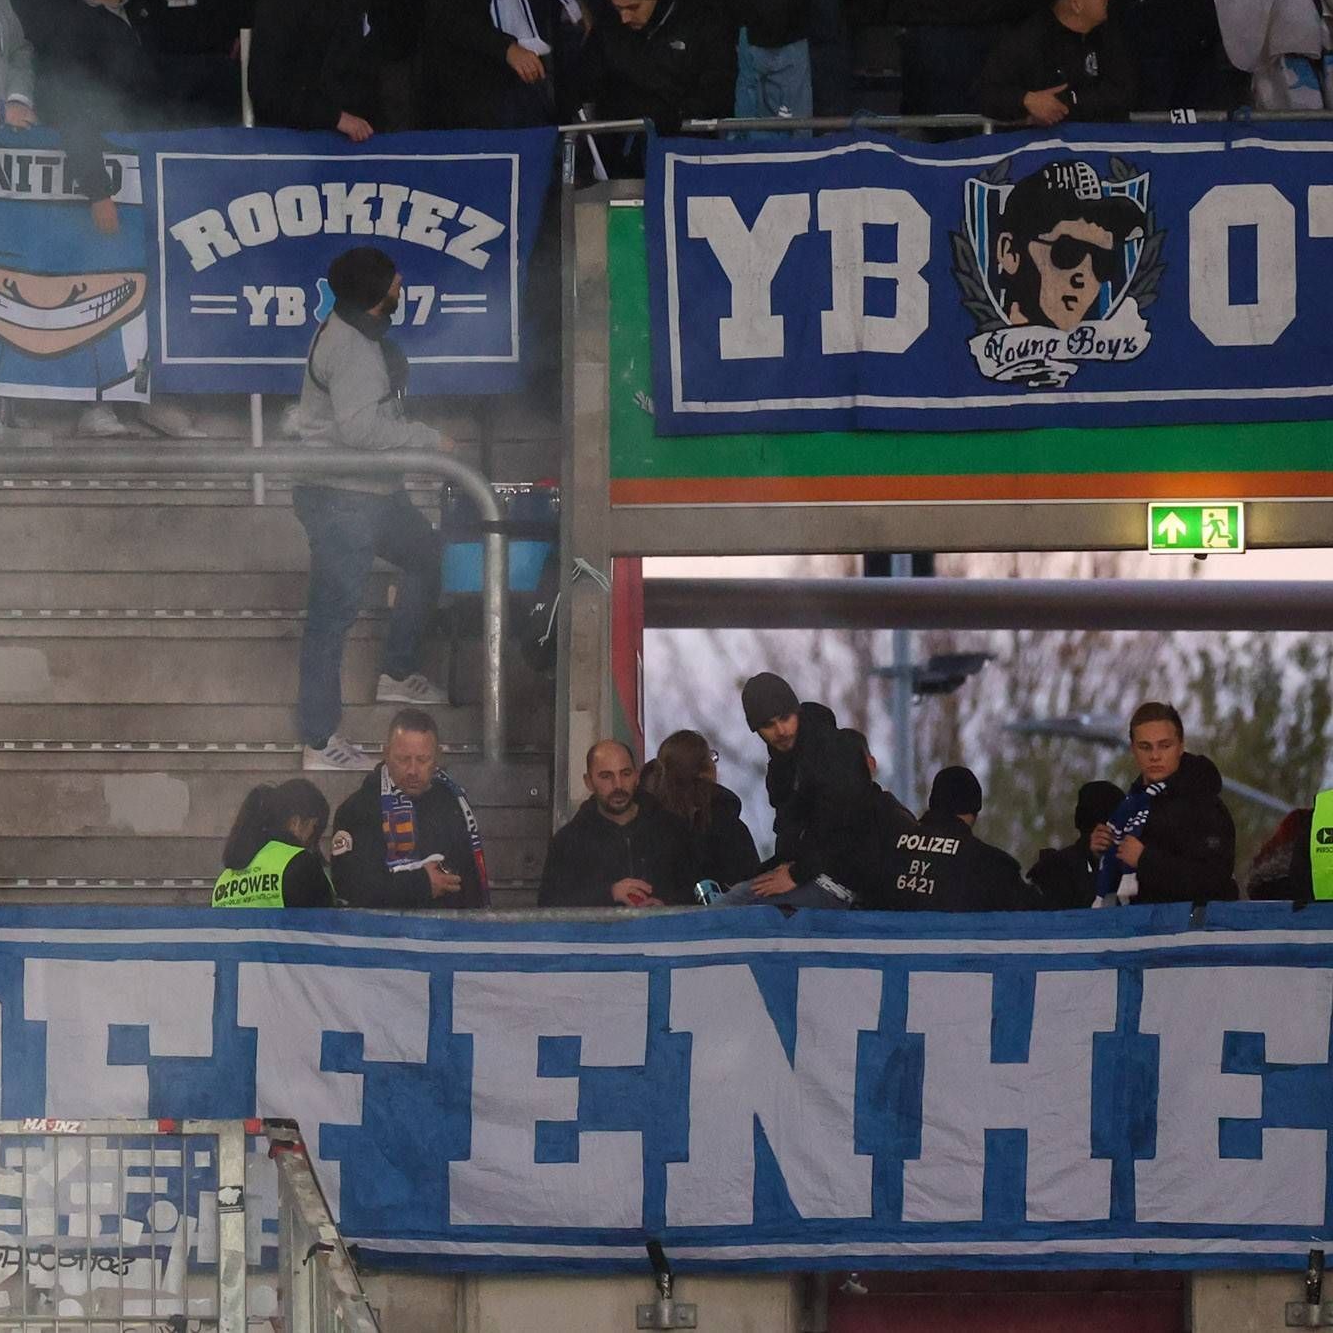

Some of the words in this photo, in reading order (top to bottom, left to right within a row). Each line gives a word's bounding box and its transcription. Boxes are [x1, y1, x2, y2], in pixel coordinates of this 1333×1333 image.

[168, 182, 506, 273] ROOKIEZ
[687, 186, 932, 360] YB
[242, 285, 307, 327] YB
[984, 327, 1060, 367] Young
[896, 832, 961, 856] POLIZEI
[908, 859, 931, 877] BY
[229, 872, 281, 898] POWER
[896, 874, 935, 896] 6421
